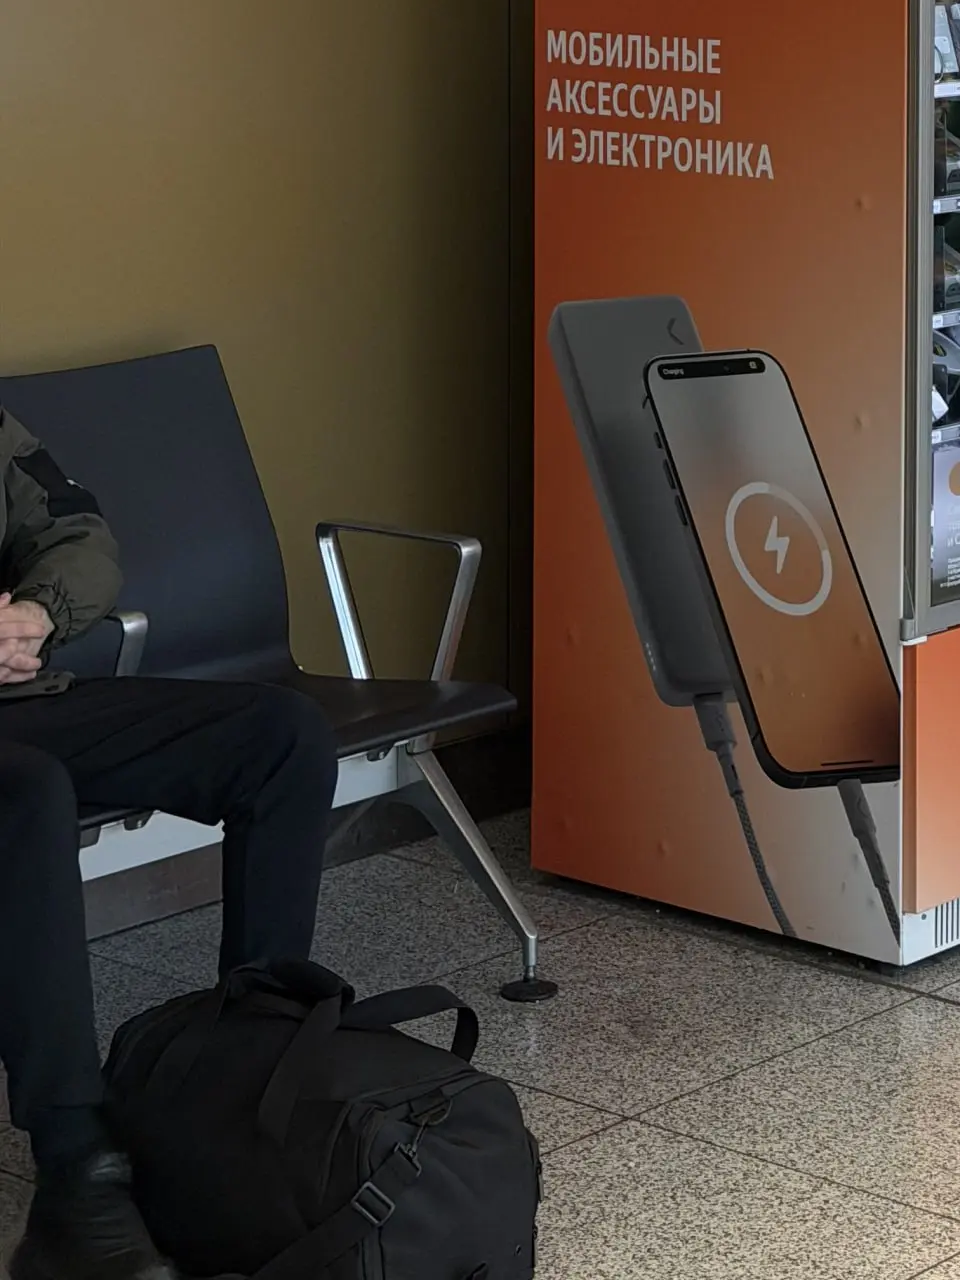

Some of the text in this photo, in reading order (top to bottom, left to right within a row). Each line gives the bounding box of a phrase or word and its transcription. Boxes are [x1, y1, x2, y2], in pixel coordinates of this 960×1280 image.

[547, 29, 721, 74] МОБИЛЬНЫЕ
[546, 78, 721, 125] АКСЕССУАРЫ
[547, 126, 775, 180] И ЭЛЕКТРОНИКА
